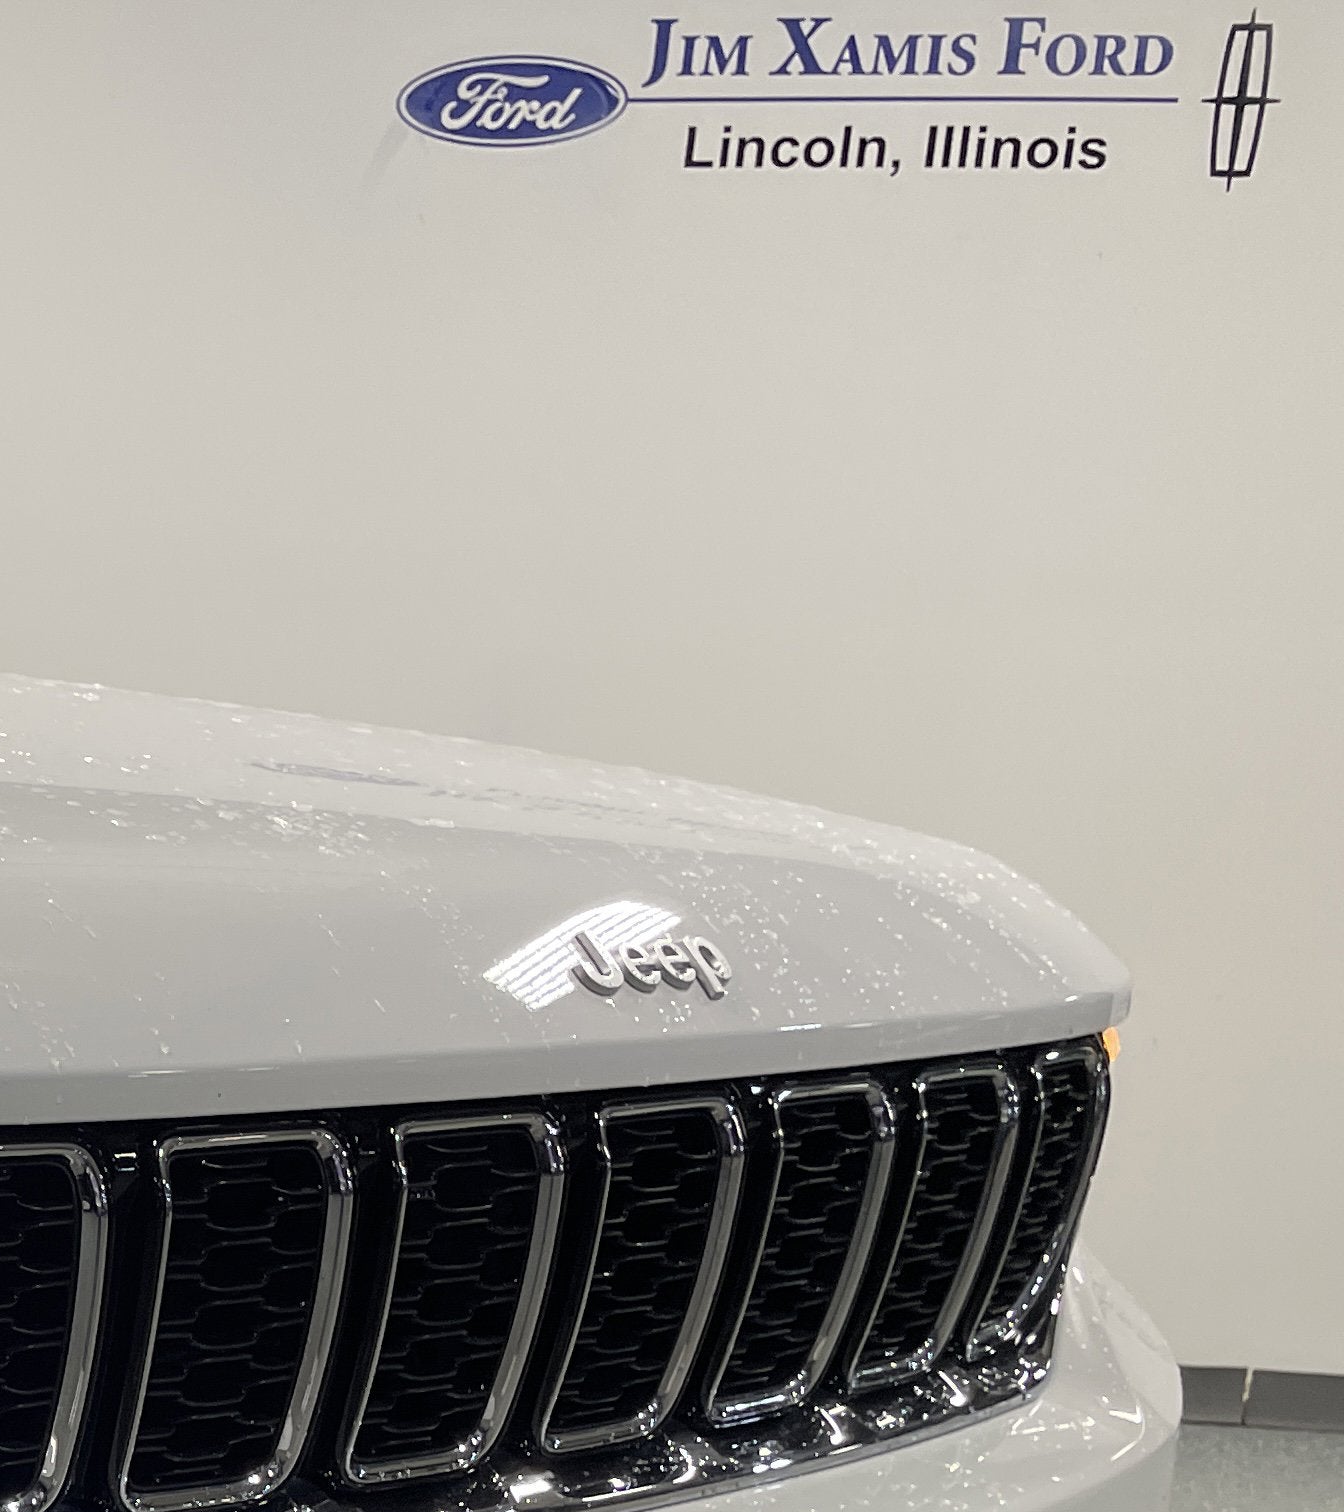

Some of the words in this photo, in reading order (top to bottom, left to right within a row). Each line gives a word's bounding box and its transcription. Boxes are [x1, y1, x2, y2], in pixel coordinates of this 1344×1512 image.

[440, 71, 583, 130] Ford
[684, 125, 901, 177] Lincoln,
[924, 125, 1107, 170] Illinois
[568, 930, 733, 1001] Jeep
